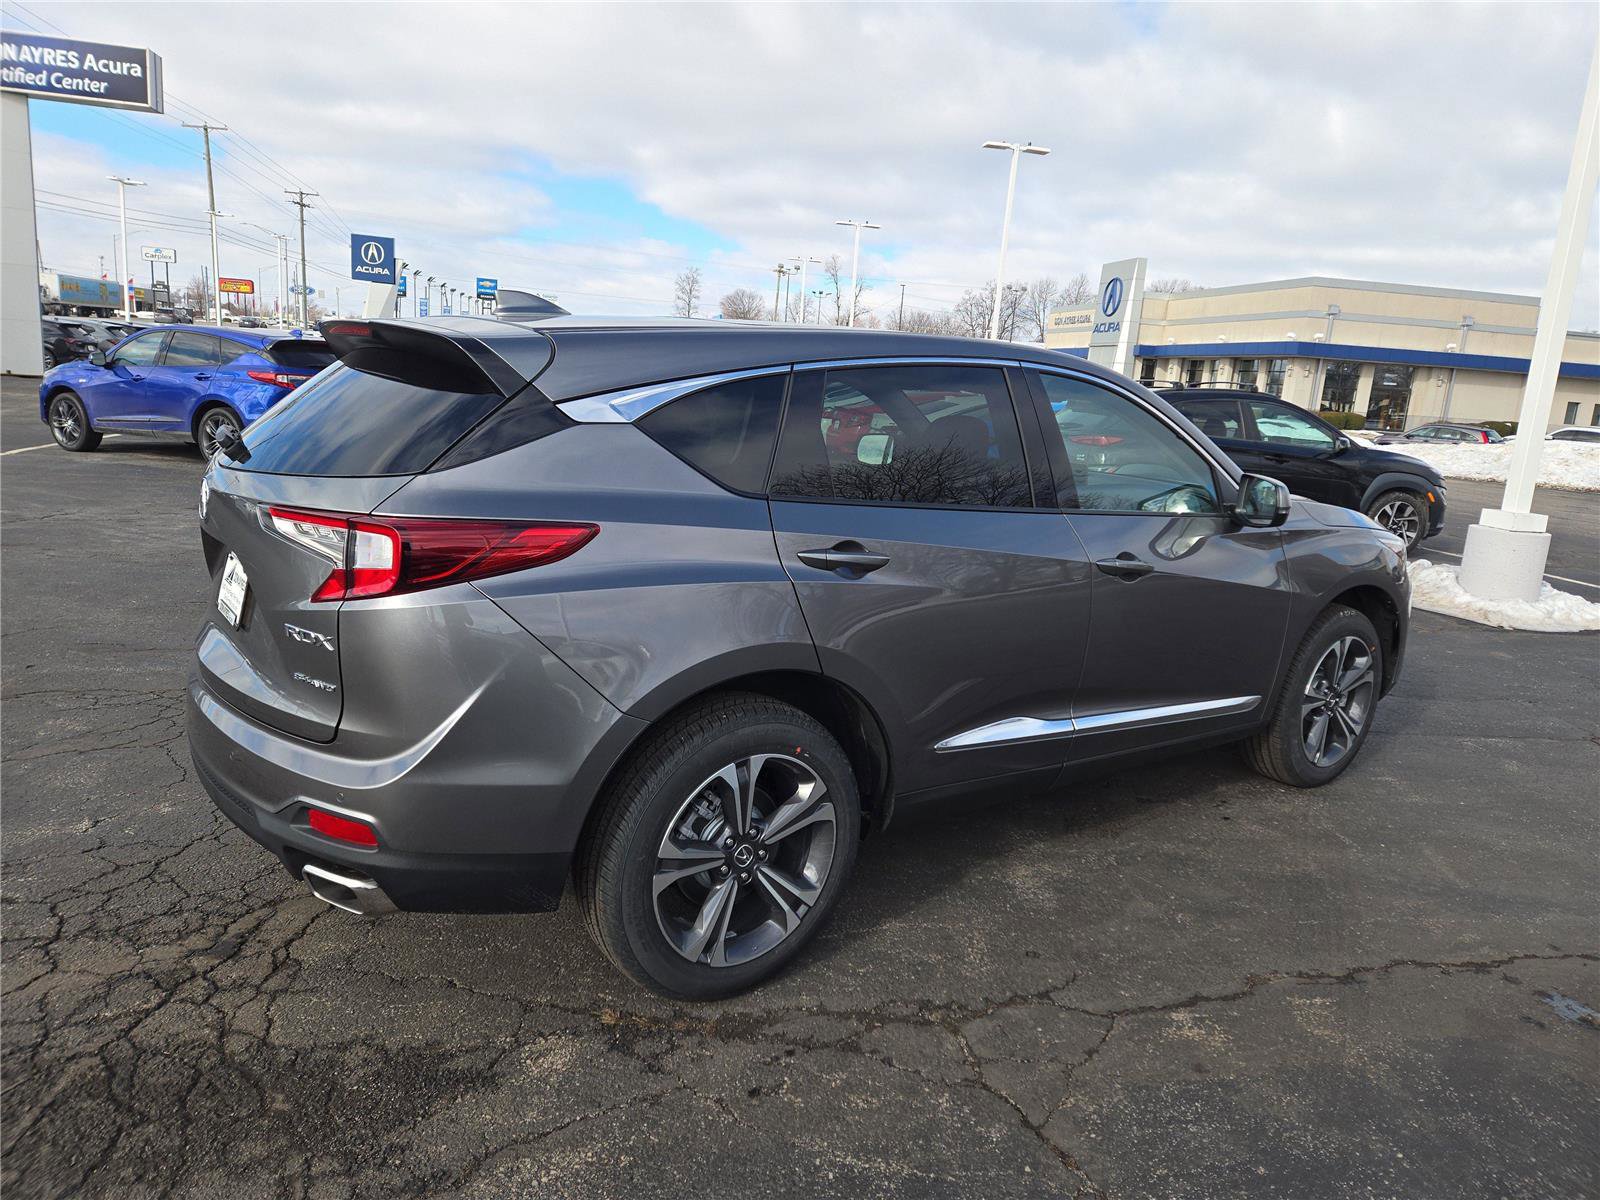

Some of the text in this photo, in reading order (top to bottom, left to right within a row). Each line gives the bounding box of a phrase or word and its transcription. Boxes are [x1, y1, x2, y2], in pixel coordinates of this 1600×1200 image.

[0, 42, 143, 77] N AYRES Acura
[50, 72, 109, 93] Center
[355, 265, 391, 275] ACURA
[1093, 322, 1120, 333] ACURA
[284, 623, 335, 651] RDX
